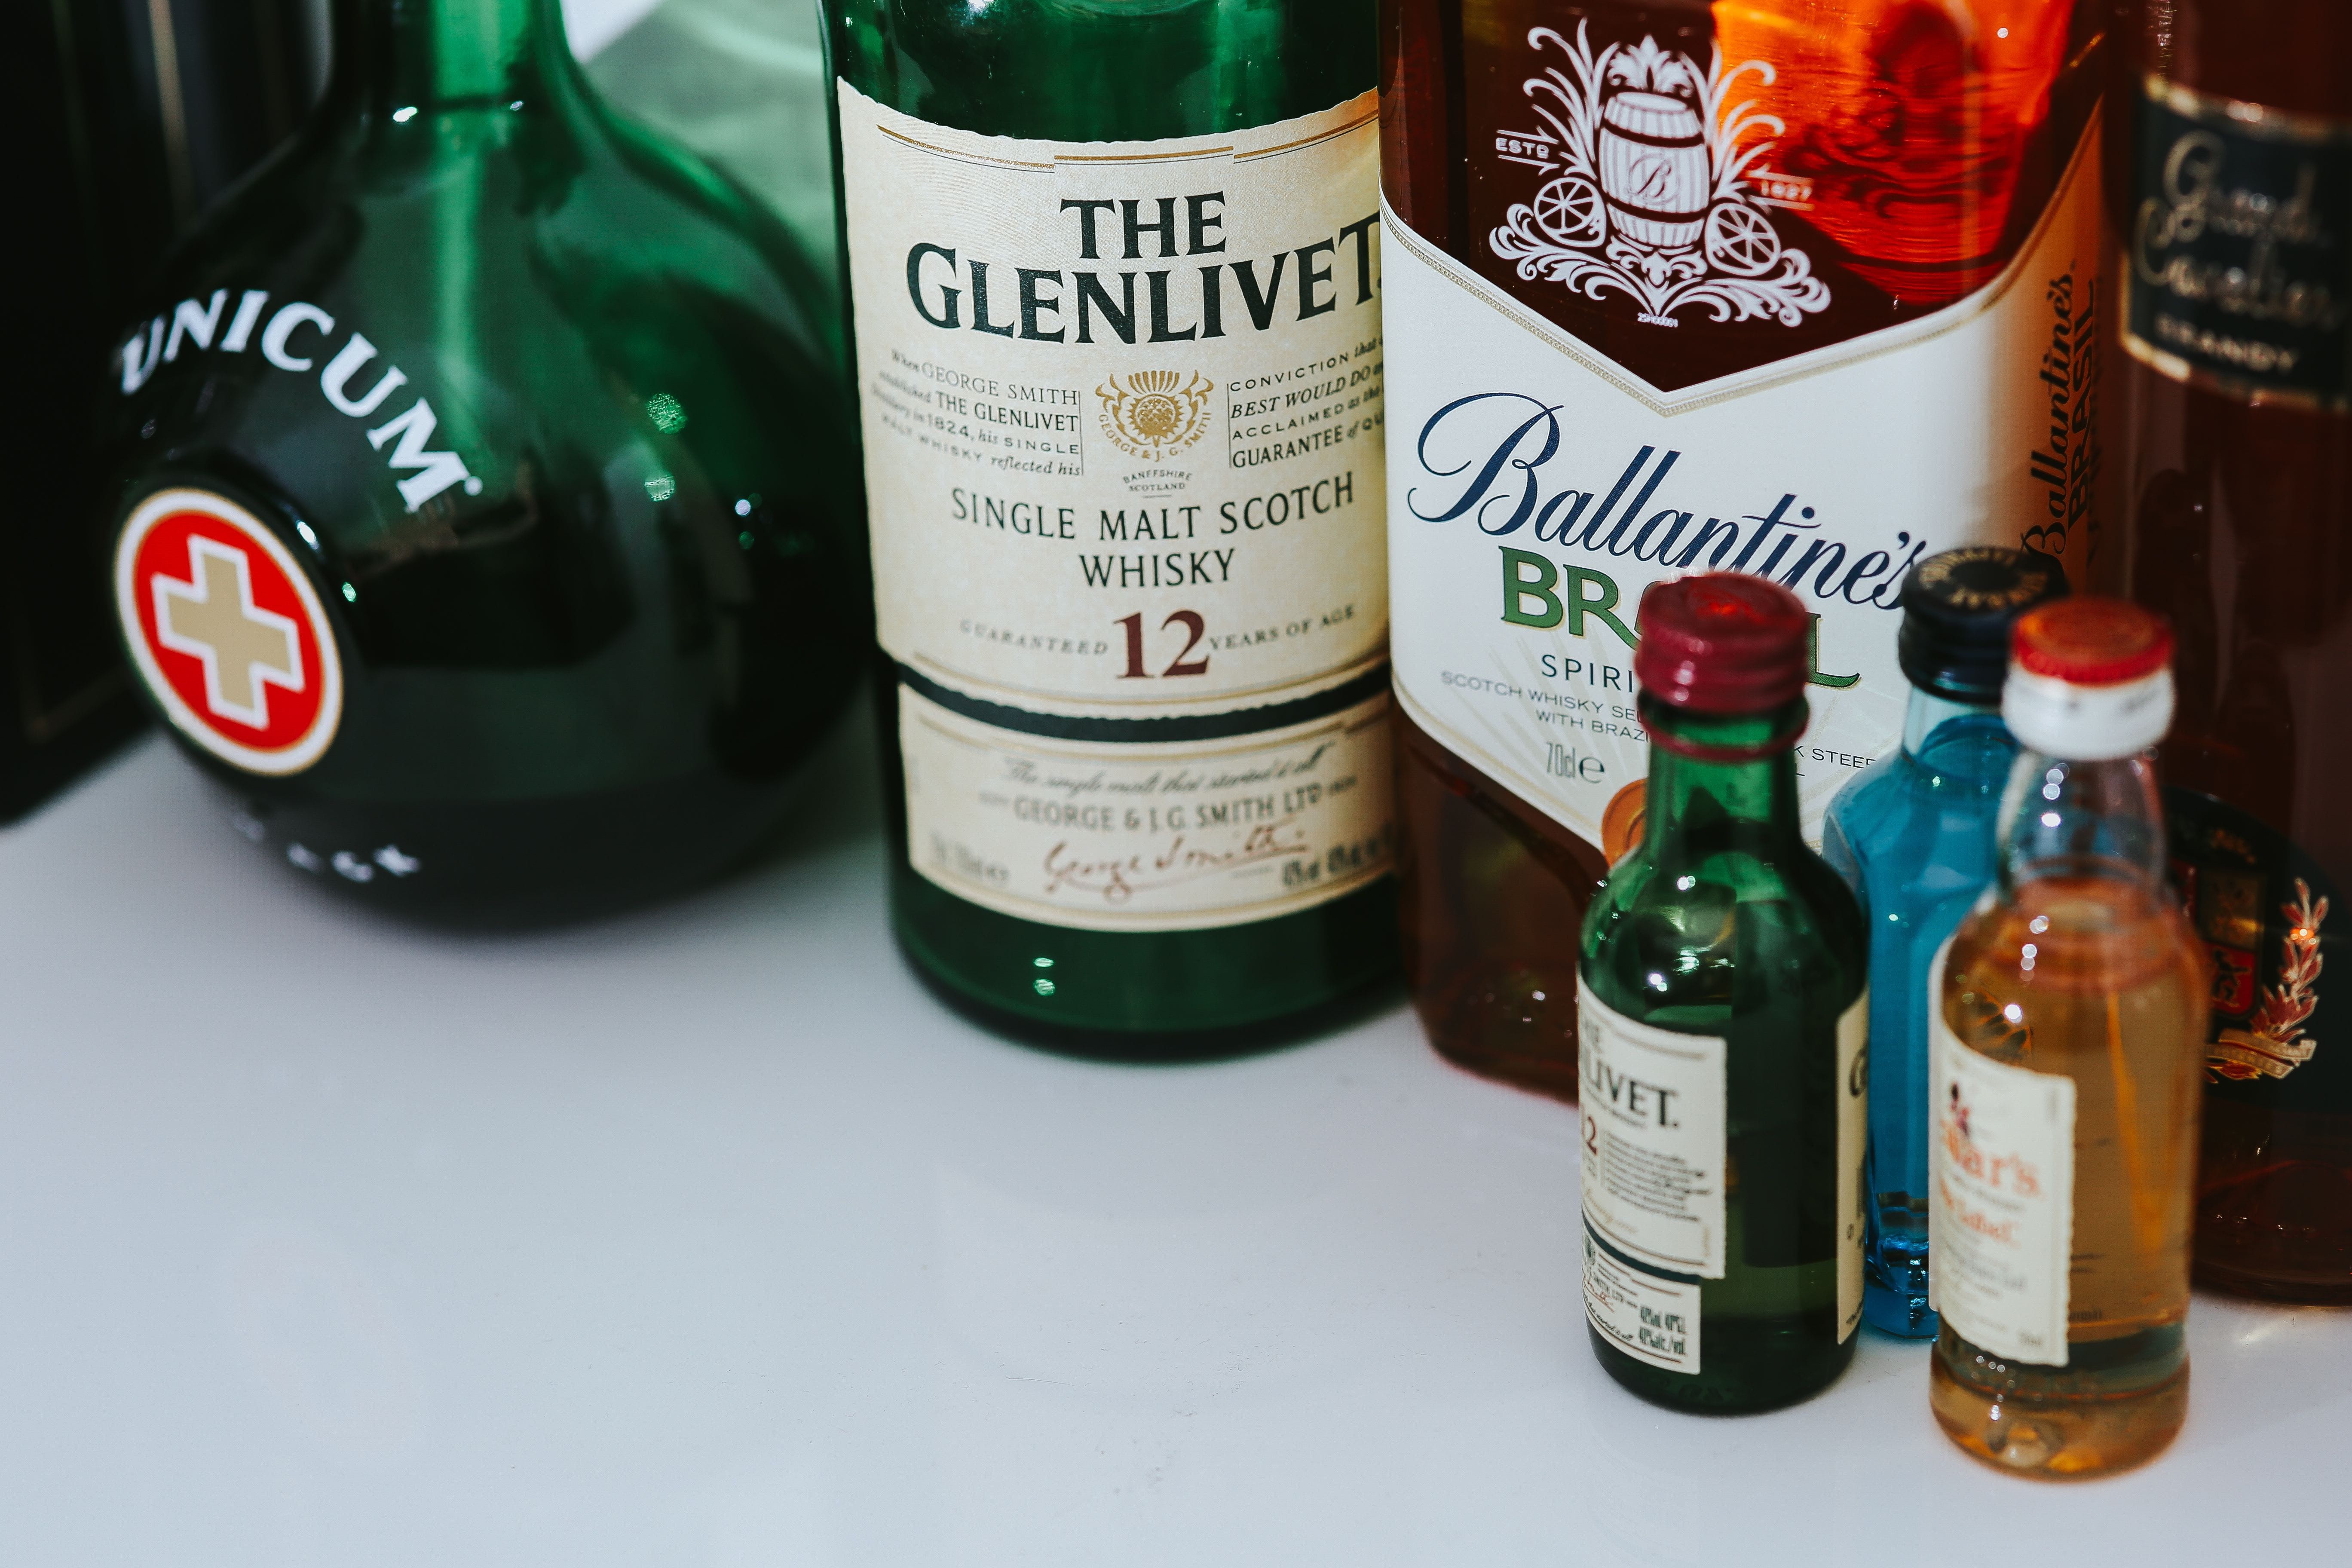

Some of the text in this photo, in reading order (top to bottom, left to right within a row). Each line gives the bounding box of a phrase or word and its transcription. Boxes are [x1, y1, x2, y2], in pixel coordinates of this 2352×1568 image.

[1496, 138, 1549, 159] ESTD
[1059, 190, 1227, 259] THE
[922, 362, 998, 396] GEORGE
[1008, 384, 1077, 405] SMITH
[1230, 352, 1348, 392] CONVICTION
[1231, 396, 1280, 419] BEST
[1286, 377, 1345, 408] WOULD
[1351, 365, 1371, 386] DO
[119, 288, 471, 514] UNICUM
[936, 389, 967, 415] THE
[974, 402, 1078, 432] GLENLIVET
[1232, 403, 1344, 440] ACCLAIMED
[2020, 273, 2073, 555] Ballantine's
[2067, 279, 2094, 534] BRASIL
[917, 432, 982, 462] WHISKY
[991, 455, 1052, 475] reflected
[1058, 462, 1080, 477] his
[928, 413, 974, 441] 1824,
[978, 429, 998, 444] his
[1004, 437, 1079, 455] SINGLE
[1099, 414, 1138, 456] GEORGE
[1142, 450, 1151, 459] &
[1184, 412, 1212, 448] SMITH
[1233, 425, 1342, 469] GUARANTEE
[1122, 469, 1192, 484] BANFFSHIRE
[1129, 482, 1186, 492] SCOTLAND
[952, 472, 1355, 541] SINGLE MALT SCOTCH
[1407, 391, 1927, 610] Ballantine's
[1079, 547, 1237, 588] WHISKY
[959, 603, 1357, 680] GUARANTEED 12 YEARS OF AGE
[1441, 671, 1522, 698] SCOTCH
[1528, 689, 1604, 714] WHISKY
[1541, 654, 1633, 693] SPIRI
[1535, 709, 1584, 729] WITH
[1014, 794, 1114, 832] GEORGE
[1197, 793, 1274, 829] SMITH
